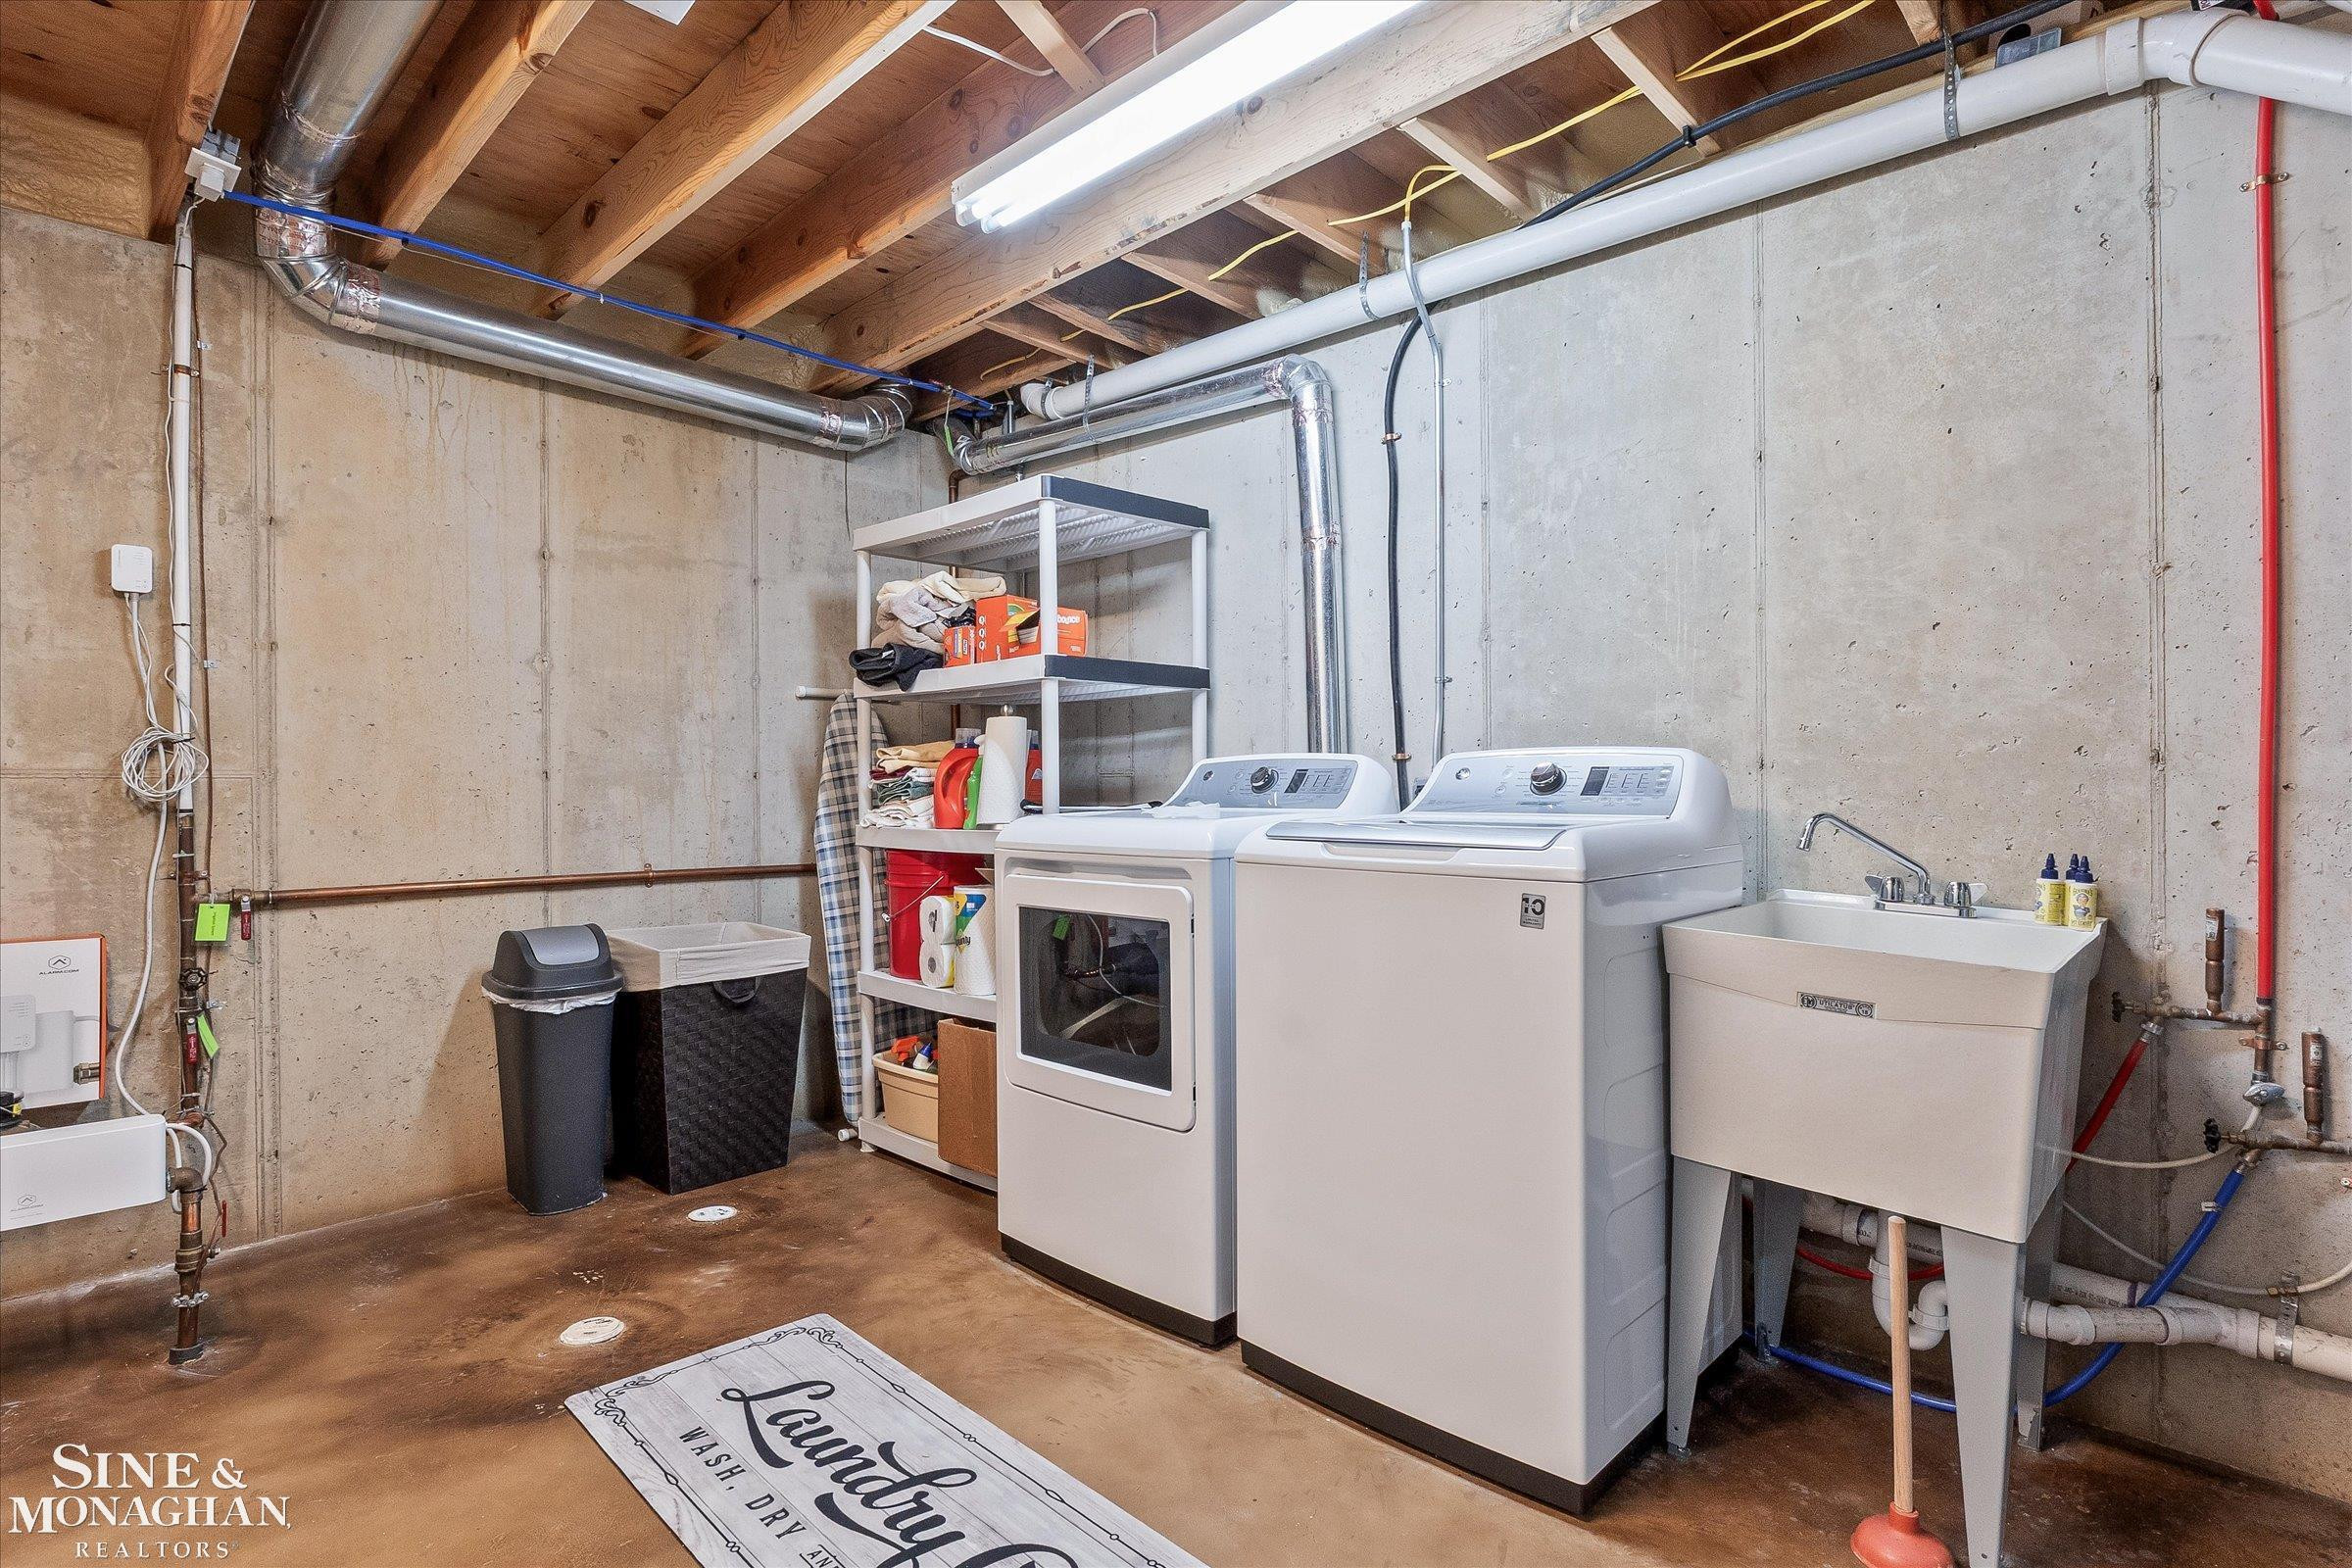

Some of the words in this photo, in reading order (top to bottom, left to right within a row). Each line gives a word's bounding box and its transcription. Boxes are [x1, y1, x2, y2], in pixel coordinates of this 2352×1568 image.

[679, 1426, 747, 1491] WASH,
[745, 1493, 807, 1540] DRY
[807, 1549, 841, 1568] AN
[720, 1380, 978, 1568] Laundry
